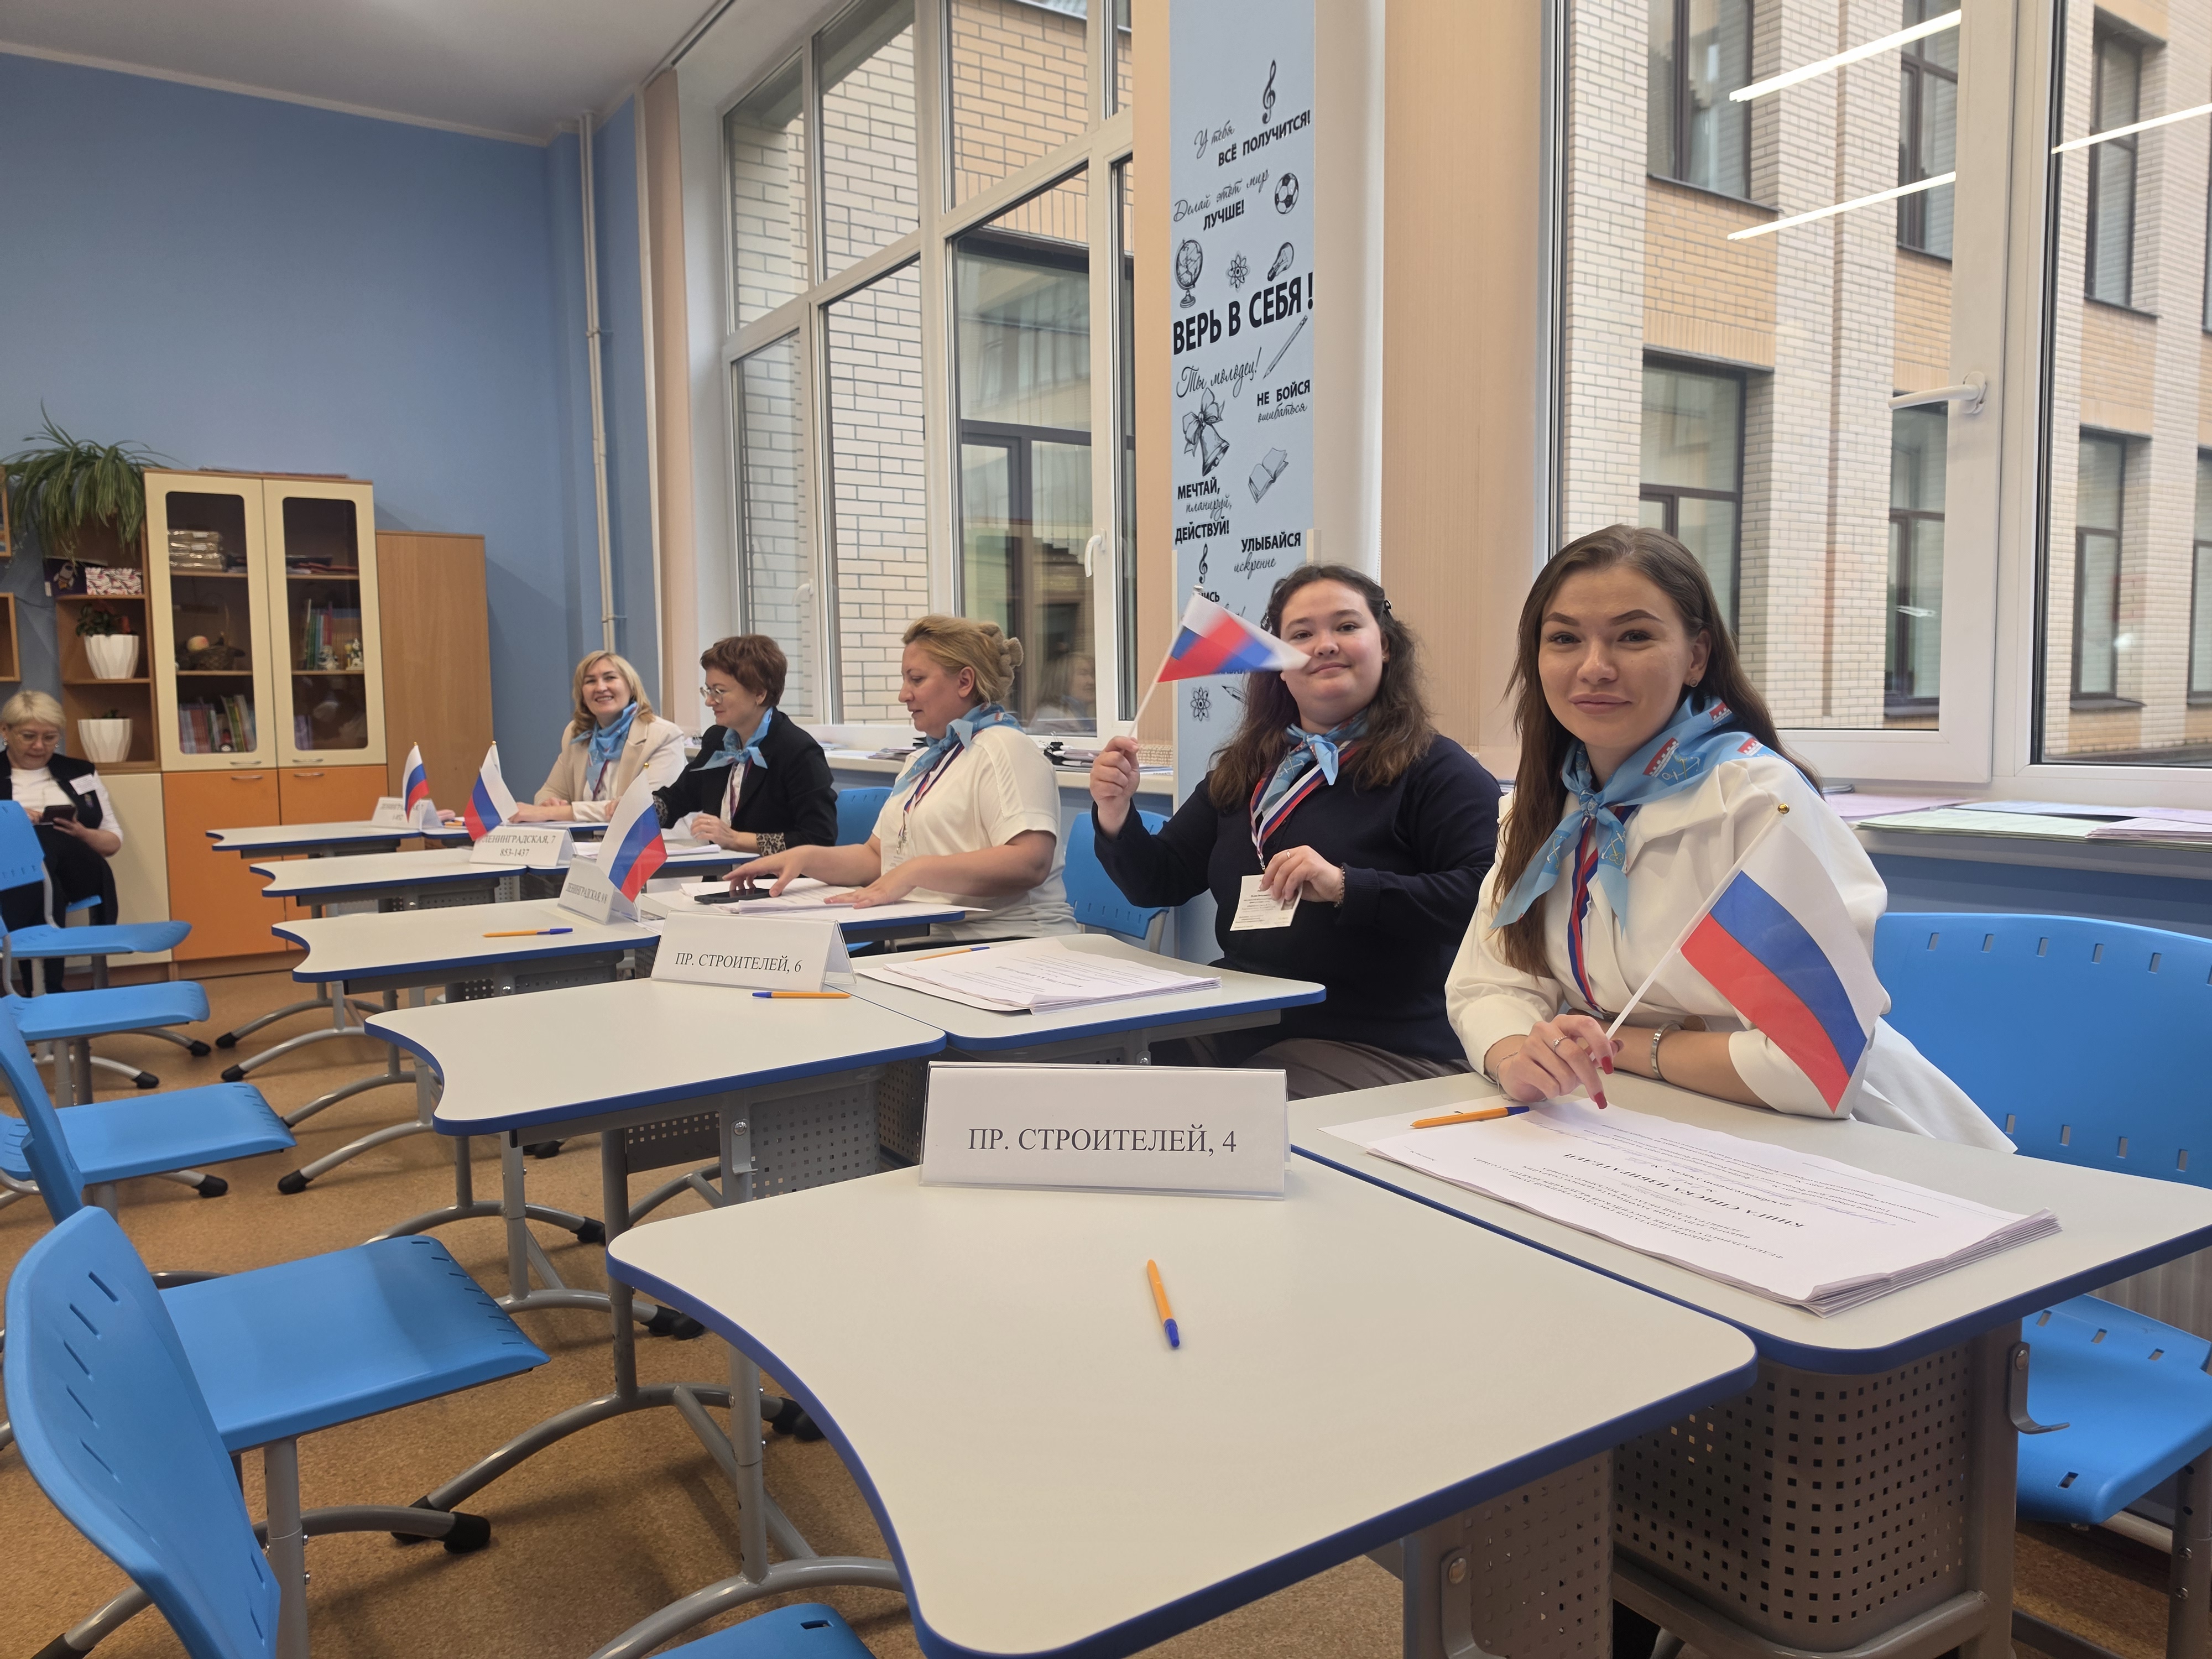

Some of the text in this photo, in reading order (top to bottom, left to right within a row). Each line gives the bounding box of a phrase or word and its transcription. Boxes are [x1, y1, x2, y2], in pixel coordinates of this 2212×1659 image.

[1194, 120, 1235, 159] У тебя
[1218, 110, 1311, 166] ВСЁ ПОЛУЧИТСЯ!
[1173, 195, 1211, 222] Делай
[1246, 169, 1269, 193] мир
[1203, 199, 1244, 231] ЛУЧШЕ!
[1173, 309, 1222, 355] ВЕРЬ
[1229, 300, 1241, 337] В
[1176, 346, 1262, 398] Ты молодец!
[1257, 379, 1311, 407] НЕ БОЙСЯ
[1258, 403, 1307, 423] ошибаться
[1177, 477, 1221, 500] МЕЧТАЙ,
[1175, 519, 1230, 545] ДЕЙСТВУЙ!
[1241, 531, 1301, 554] УЛЫБАЙСЯ
[1234, 552, 1276, 580] искренне
[500, 848, 530, 857] 853-1437
[675, 952, 802, 973] ПР. СТРОИТЕЛЕЙ, 6
[968, 1124, 1237, 1157] ПР. СТРОИТЕЛЕЙ, 4
